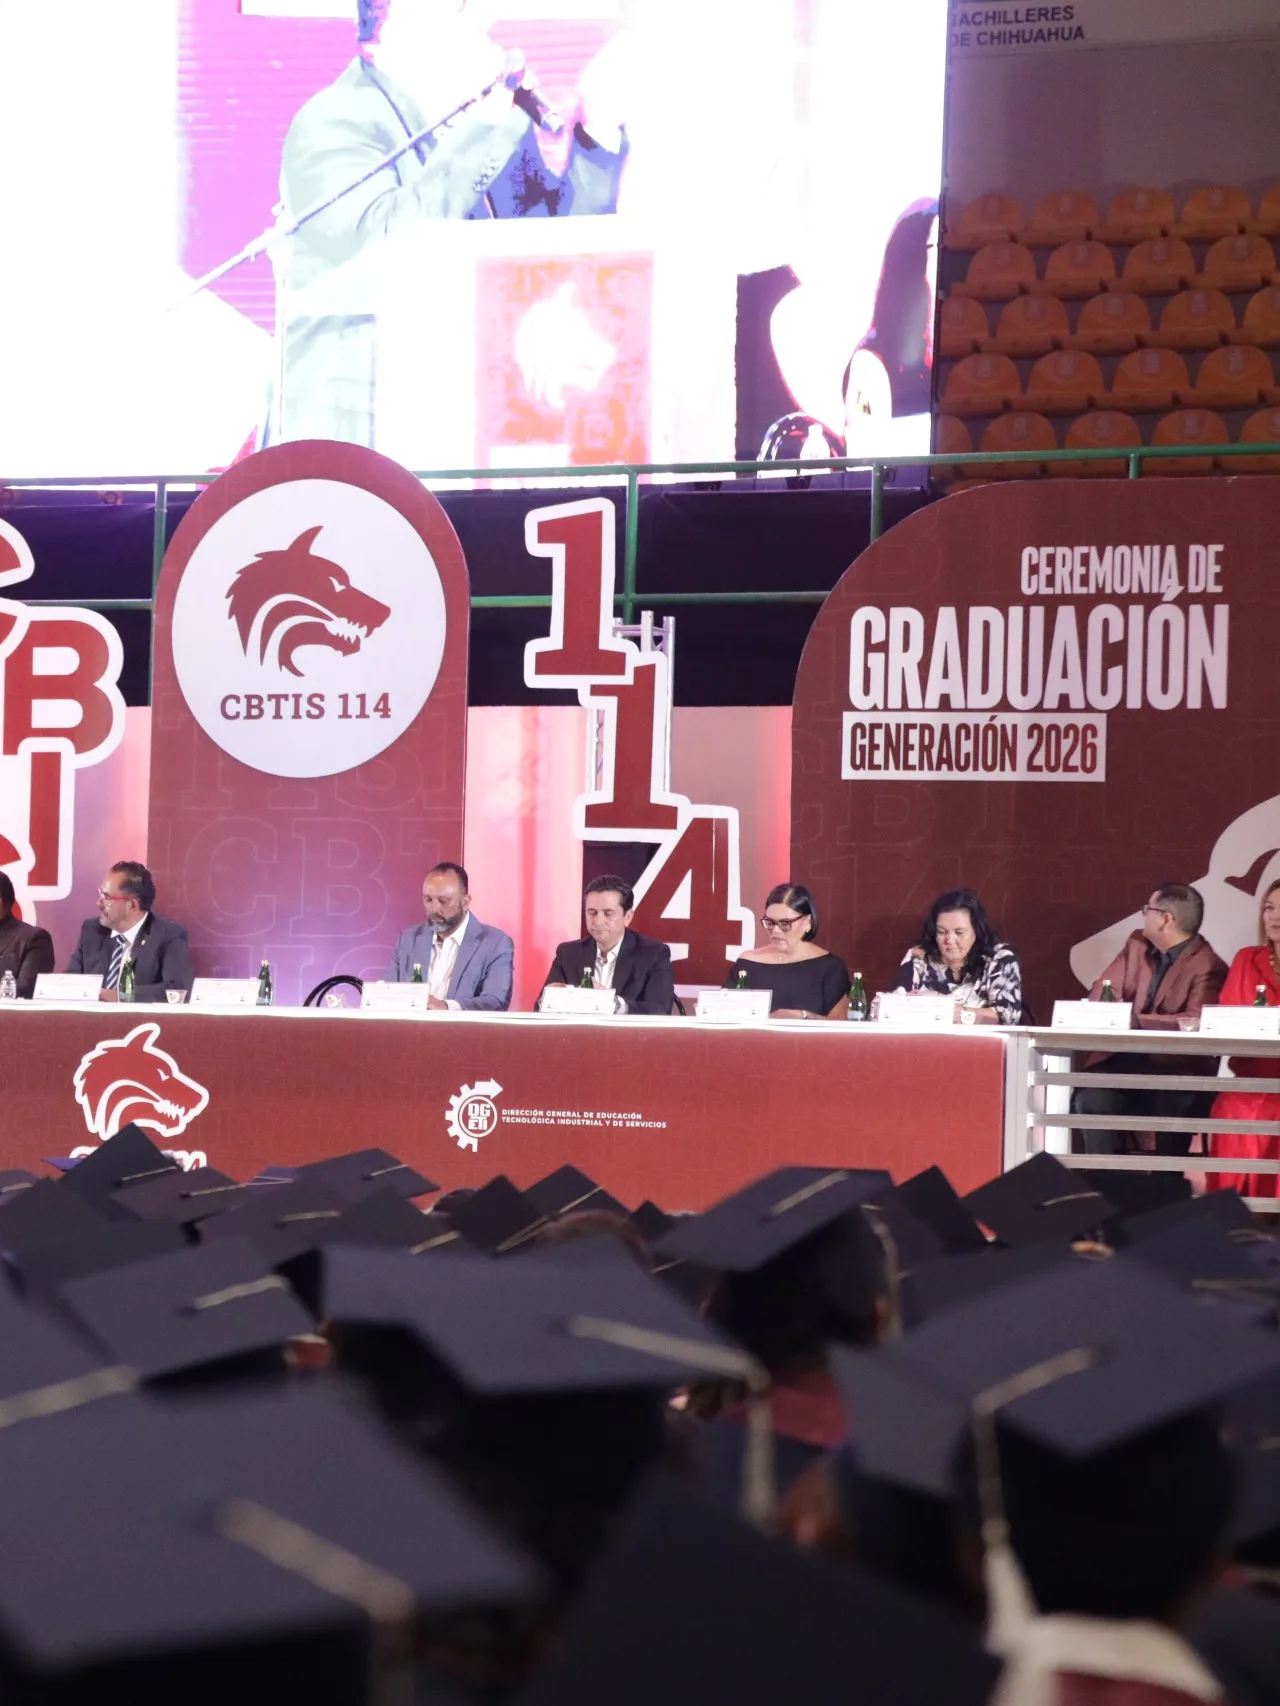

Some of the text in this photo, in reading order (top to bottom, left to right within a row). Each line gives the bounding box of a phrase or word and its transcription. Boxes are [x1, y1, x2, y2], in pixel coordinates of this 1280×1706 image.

[976, 26, 1085, 46] CHIHUAHUA
[1021, 544, 1224, 596] CEREMONIA DE
[849, 585, 1229, 711] GRADUACIÓN
[220, 692, 391, 721] CBTIS 114
[850, 715, 1098, 774] GENERACIÓN 2026
[501, 1116, 555, 1124] TECNOLÓGICA
[557, 1118, 603, 1126] INDUSTRIAL
[625, 1120, 667, 1128] SERVICIOS
